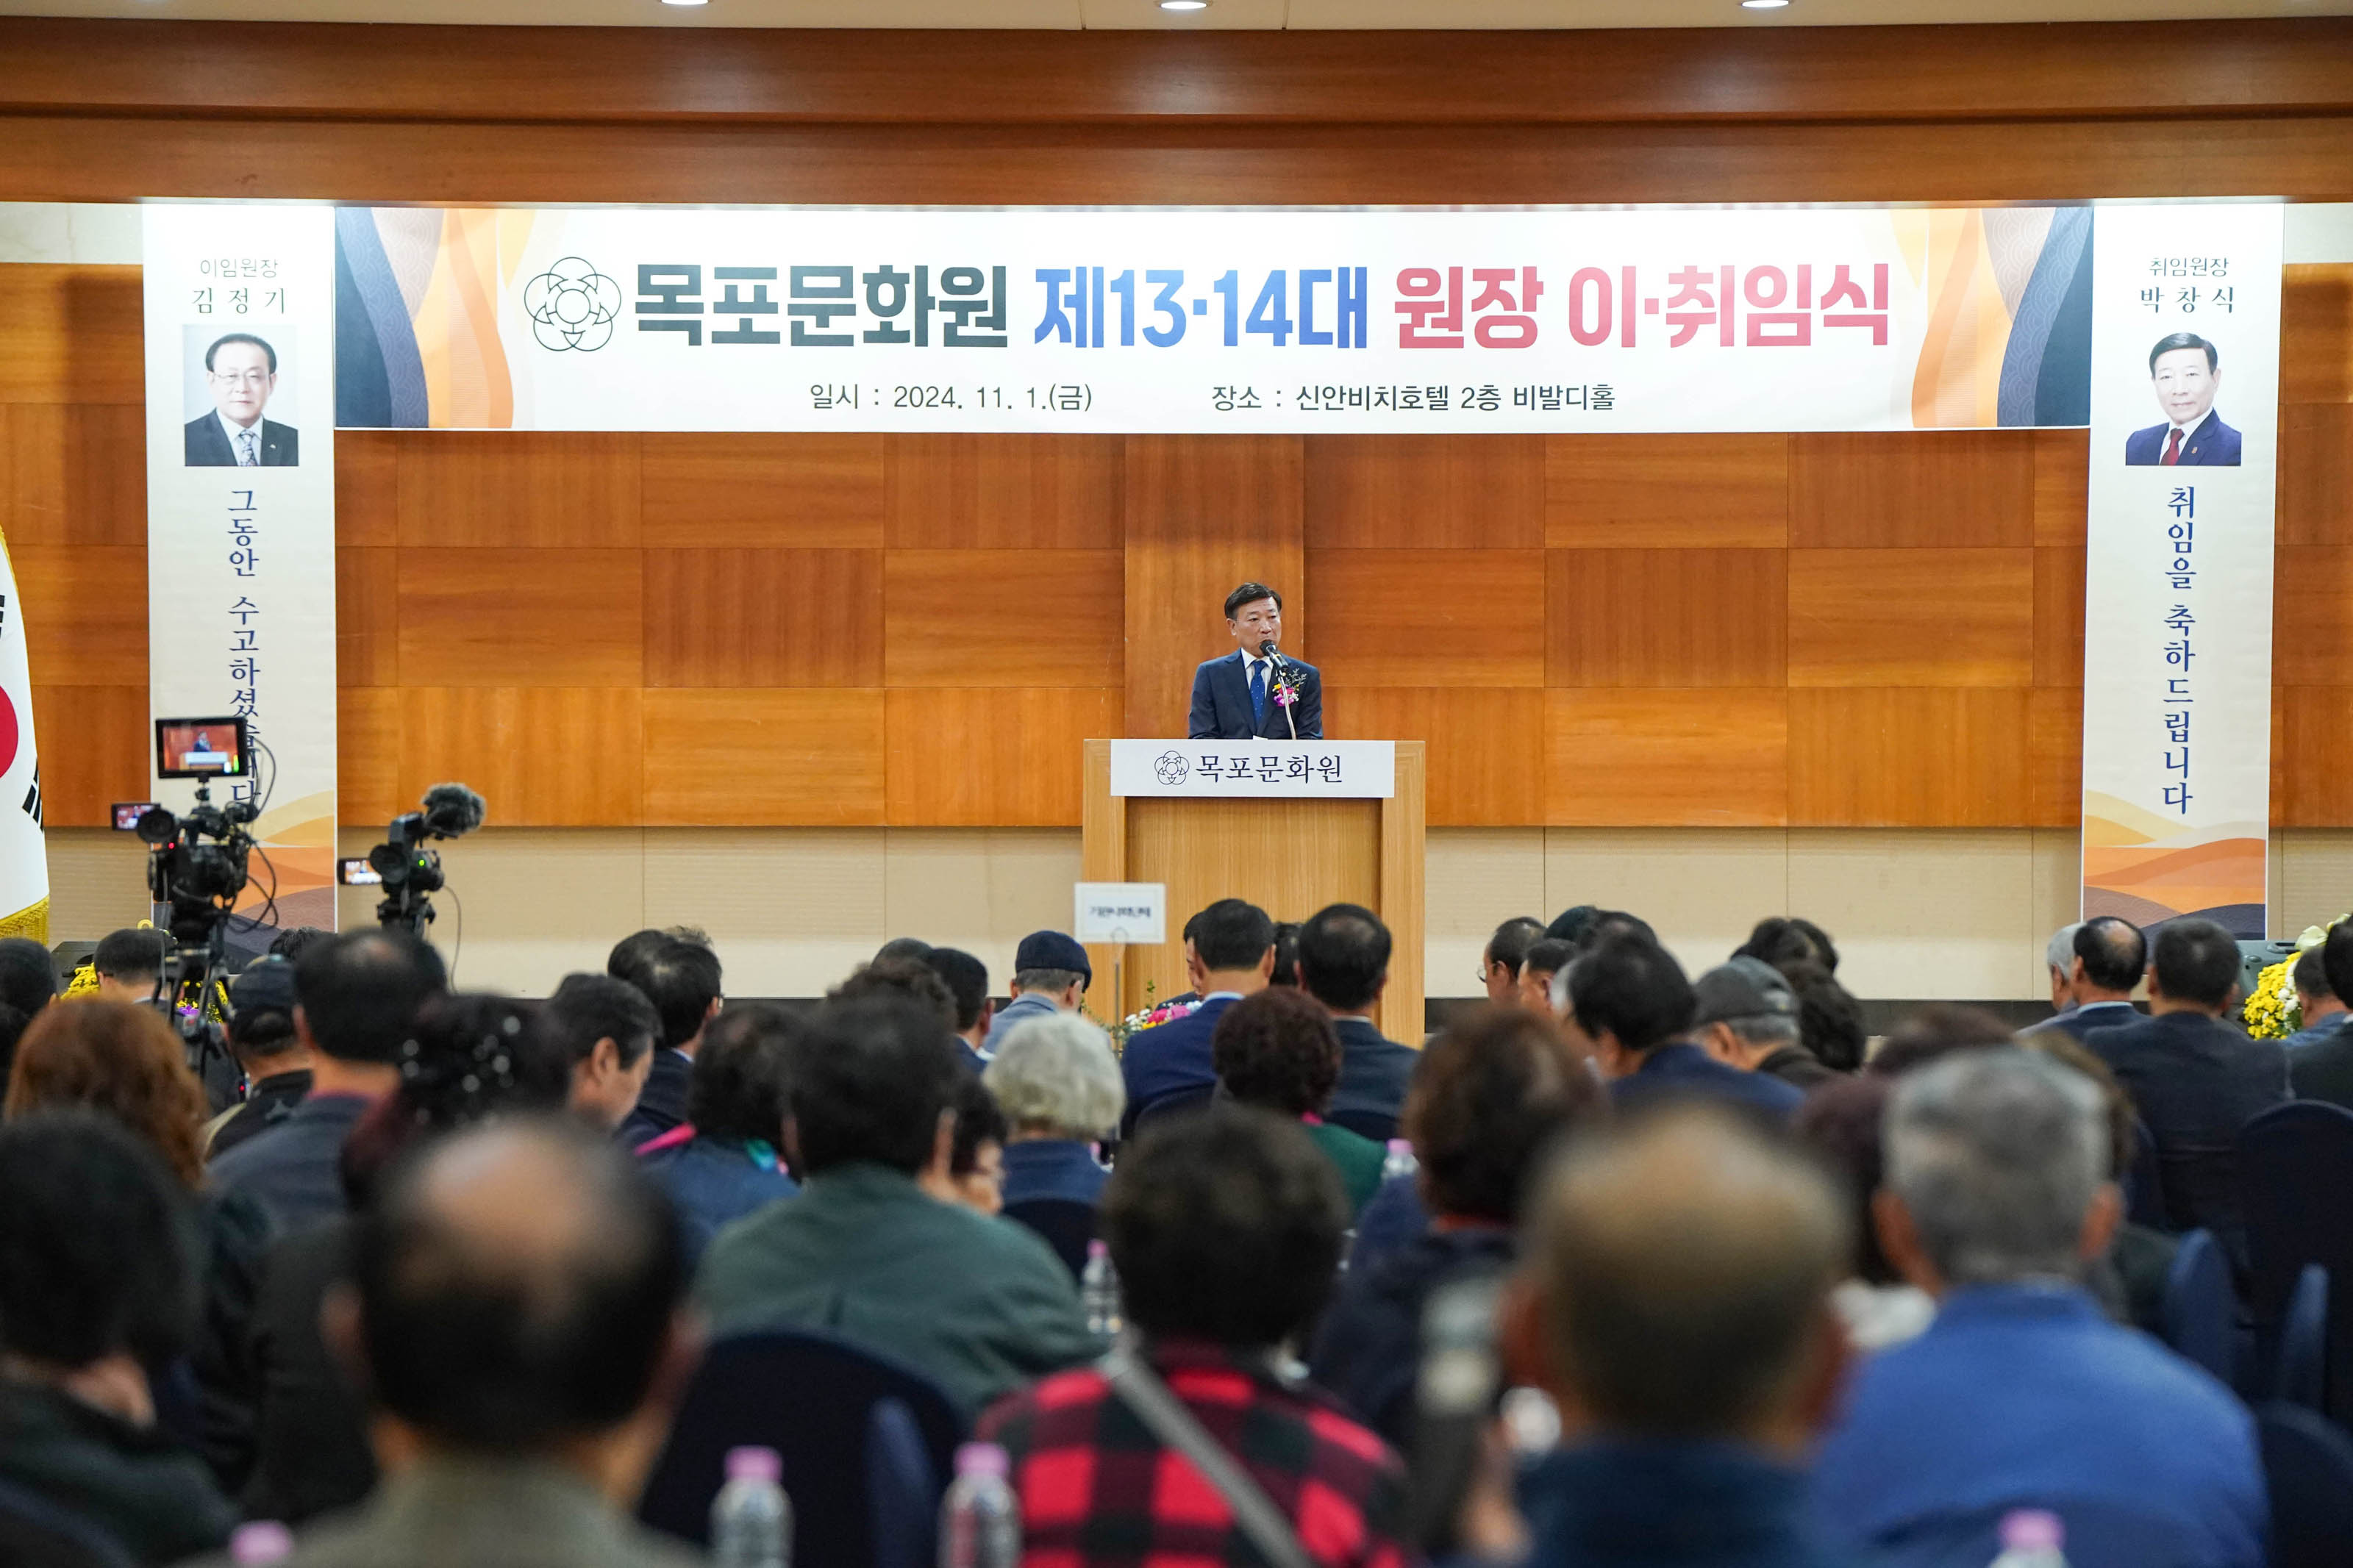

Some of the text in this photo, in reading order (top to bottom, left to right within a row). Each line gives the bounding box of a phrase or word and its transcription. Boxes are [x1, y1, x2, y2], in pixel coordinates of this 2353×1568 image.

[200, 258, 278, 279] 이임원장
[2149, 257, 2229, 277] 취임원장
[635, 262, 1889, 350] 목포문화원 제13·14대 원장 이·취임식
[810, 383, 858, 410] 일시
[893, 385, 963, 409] 2024.
[976, 386, 1013, 410] 11.
[1211, 384, 1263, 412] 장소
[1296, 384, 1449, 412] 신안비치호텔
[1460, 384, 1502, 412] 2층
[1513, 384, 1615, 412] 비발디홀
[226, 490, 260, 577] 그동안
[2161, 485, 2198, 815] 취임을 축하드립니다
[1196, 754, 1343, 784] 목포문화원
